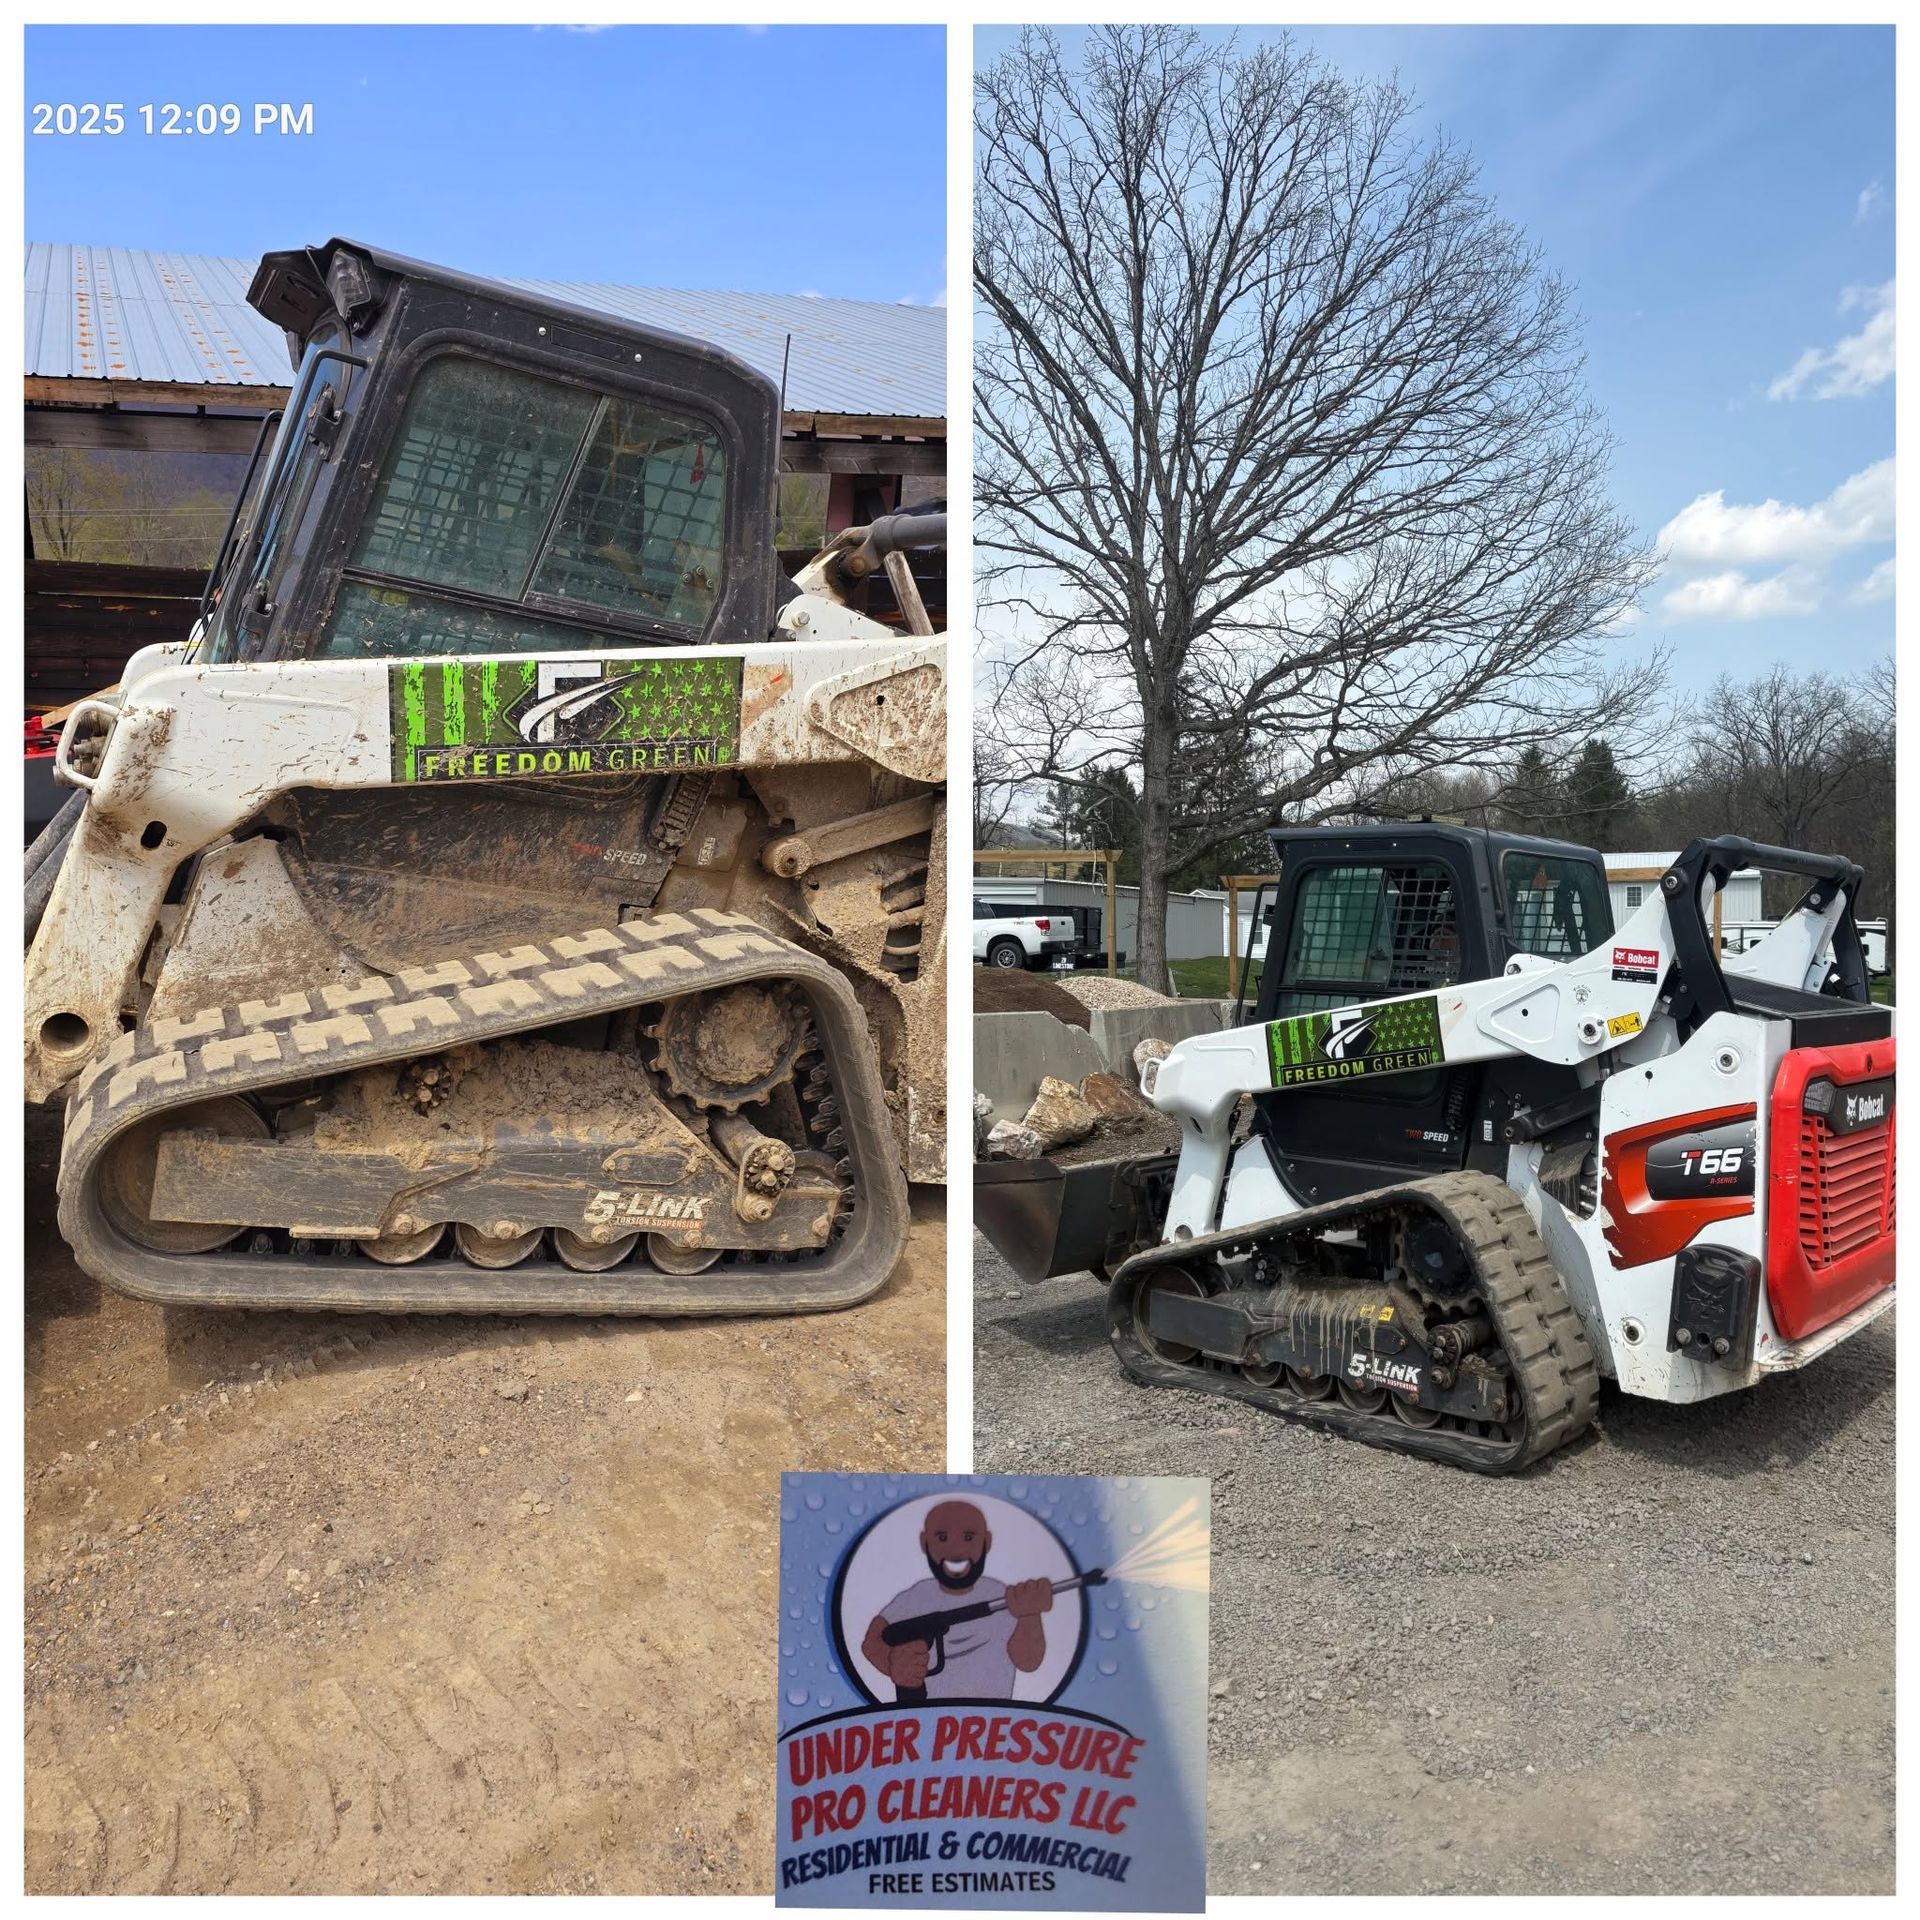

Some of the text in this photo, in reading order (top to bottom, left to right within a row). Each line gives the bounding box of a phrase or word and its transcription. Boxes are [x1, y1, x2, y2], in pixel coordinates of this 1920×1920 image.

[425, 746, 710, 777] FREEDOM GREEN
[603, 848, 648, 865] SPEED
[1627, 953, 1656, 965] Bobcat
[1285, 1052, 1428, 1083] FREEDOM GREEN
[1859, 1093, 1884, 1122] Bobcat
[1423, 1131, 1449, 1142] SPEED
[1681, 1147, 1744, 1176] T66
[584, 1190, 712, 1224] 5-LINK
[616, 1217, 702, 1229] TORSION SUSPENSION
[1348, 1353, 1422, 1384] 5-LINK
